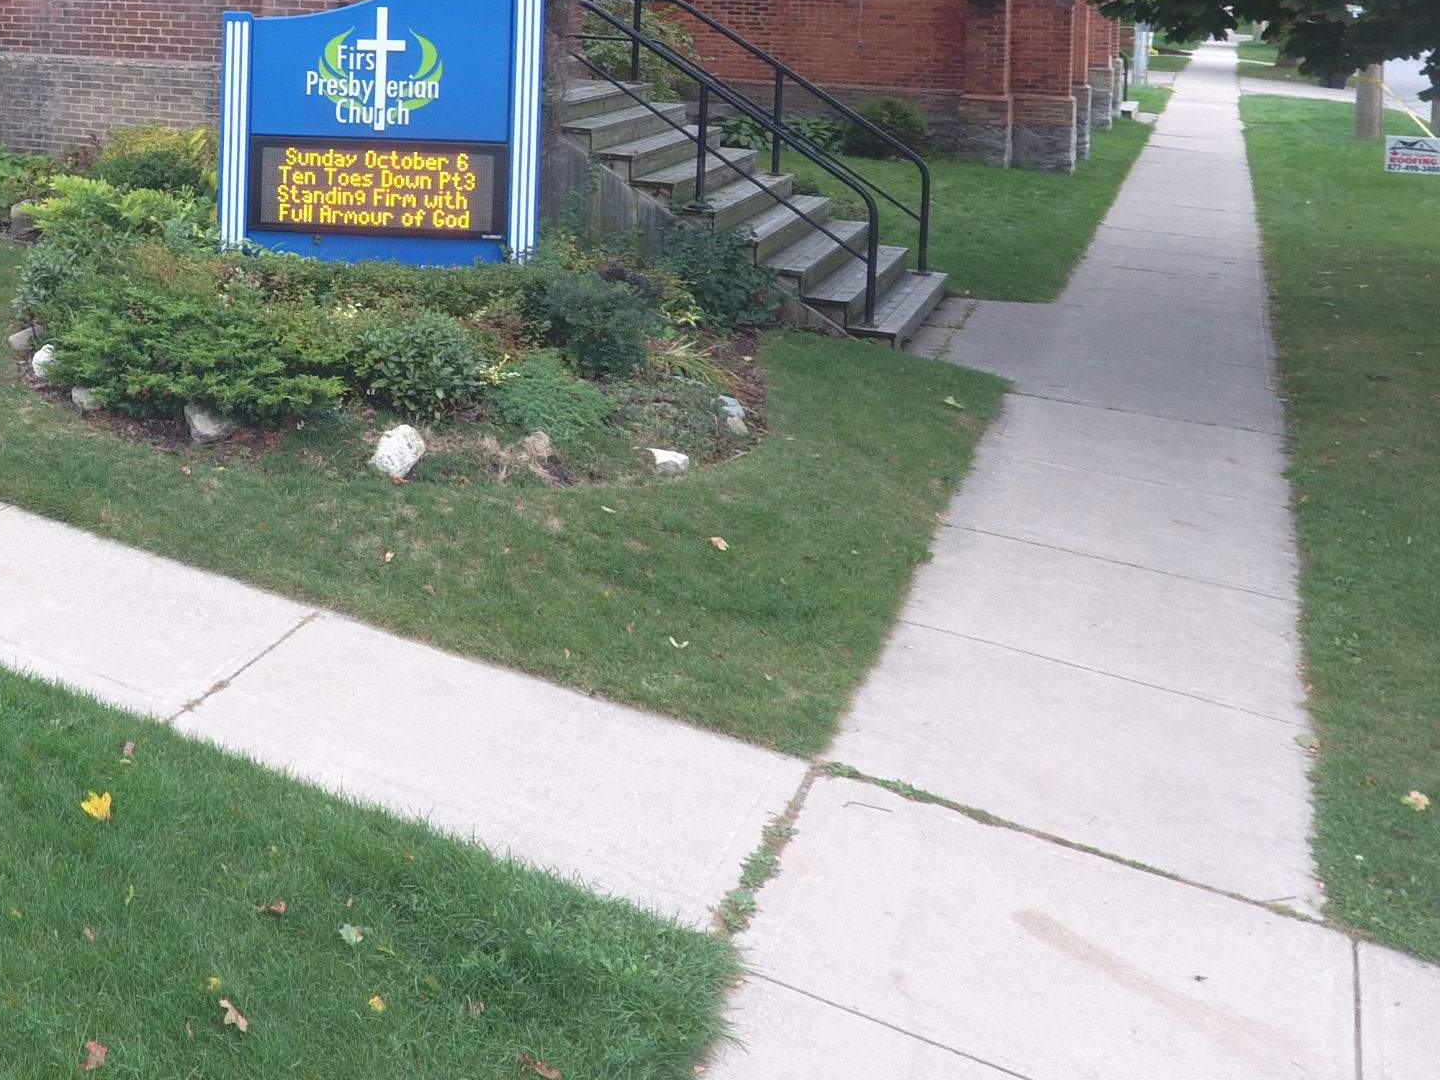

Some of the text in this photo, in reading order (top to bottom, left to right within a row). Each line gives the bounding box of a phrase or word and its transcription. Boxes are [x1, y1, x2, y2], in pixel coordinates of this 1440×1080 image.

[335, 98, 410, 126] Church
[285, 147, 469, 172] Sunday October 6
[278, 165, 316, 186] Ten
[324, 167, 374, 188] Toes
[381, 169, 432, 190] Down
[277, 184, 468, 211] Standing Firm with
[278, 203, 471, 230] Full Armour of God
